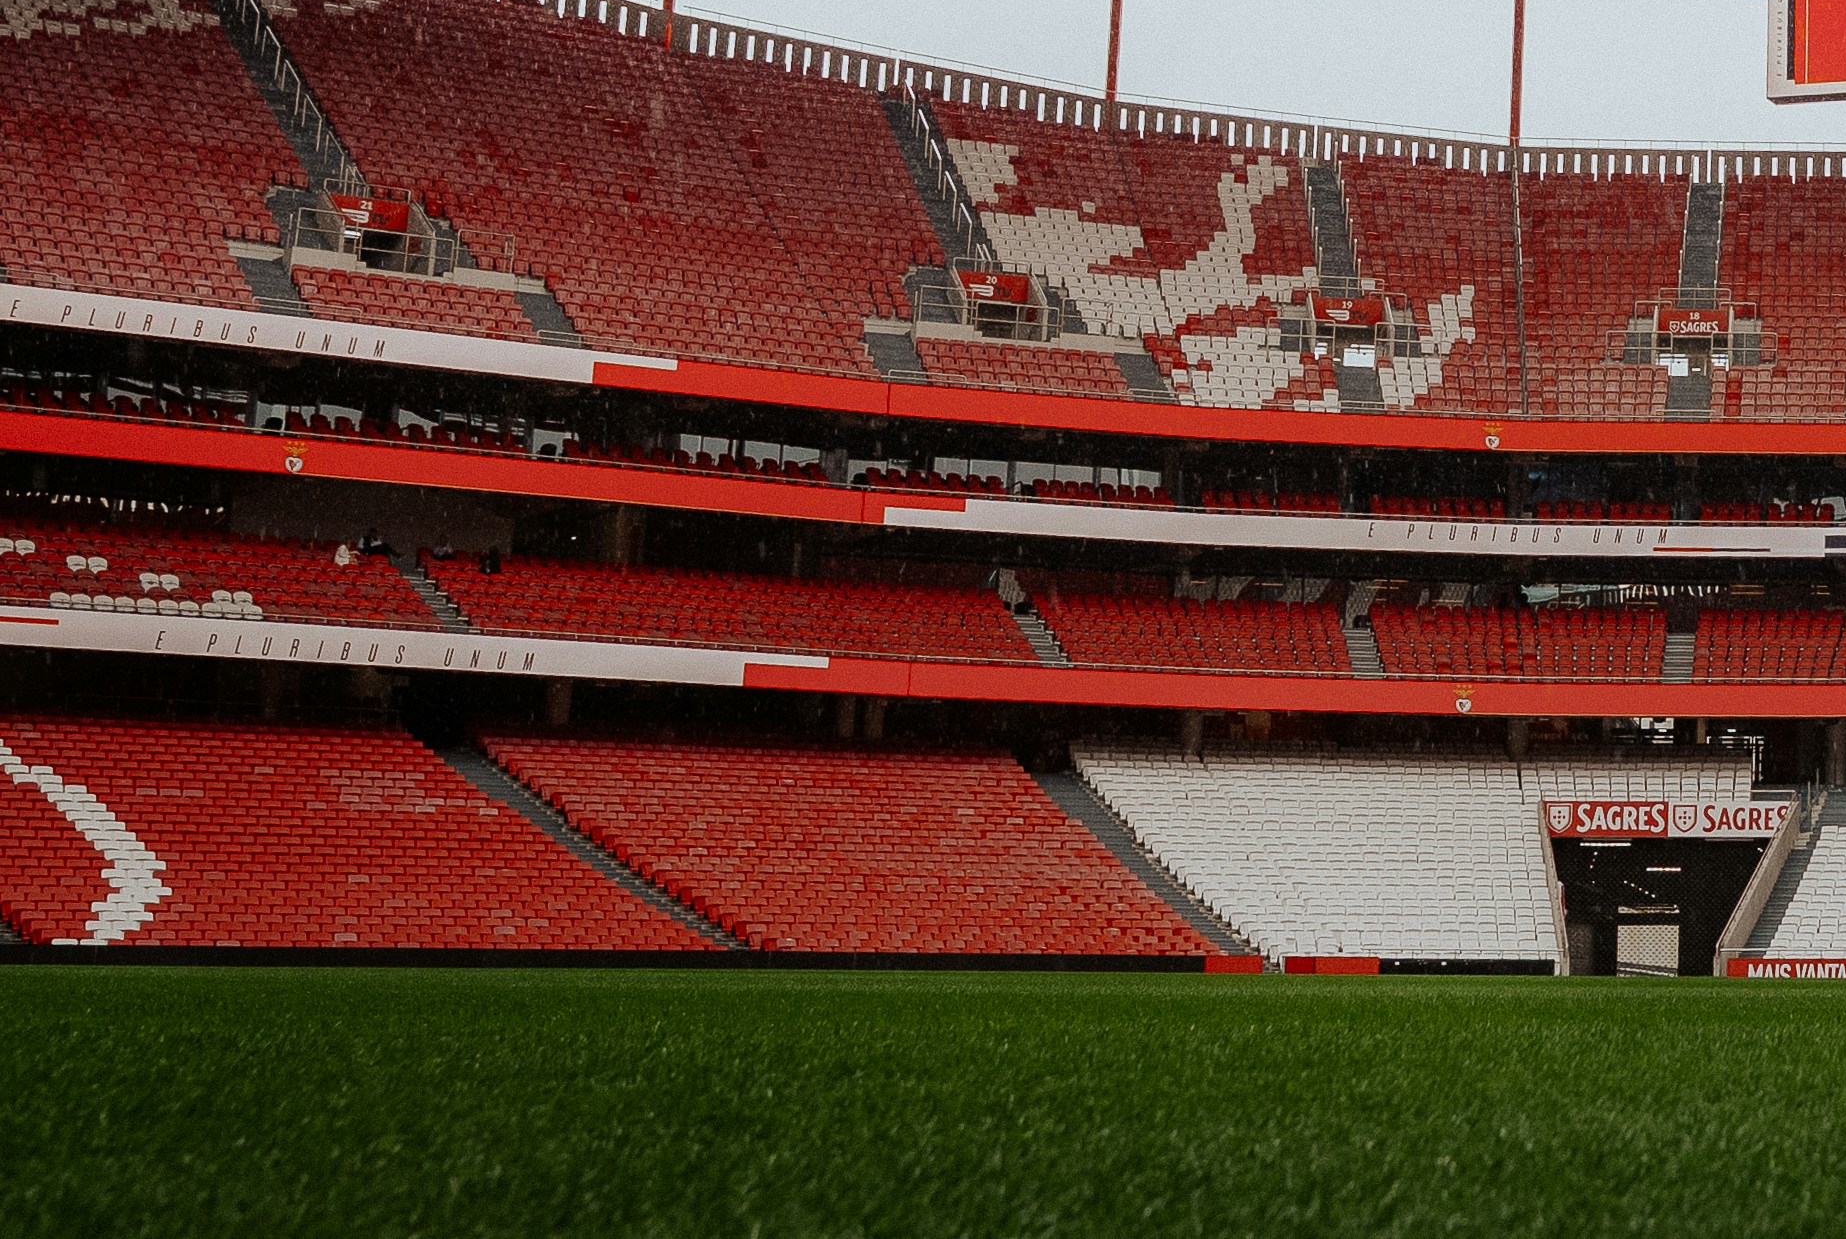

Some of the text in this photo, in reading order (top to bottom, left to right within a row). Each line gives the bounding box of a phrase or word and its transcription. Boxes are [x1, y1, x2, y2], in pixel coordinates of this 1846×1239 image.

[360, 200, 373, 210] 21
[985, 275, 998, 284] 20
[1341, 301, 1353, 309] 19
[1689, 312, 1700, 320] 18
[11, 300, 386, 357] E PLURIBUS UNUM
[1680, 321, 1719, 333] SAGRES
[1368, 522, 1668, 544] E PLURIBUS UNUM
[156, 631, 535, 671] E PLURIBUS UNUM
[1577, 803, 1665, 833] SAGRES
[1748, 963, 1791, 978] MAIS
